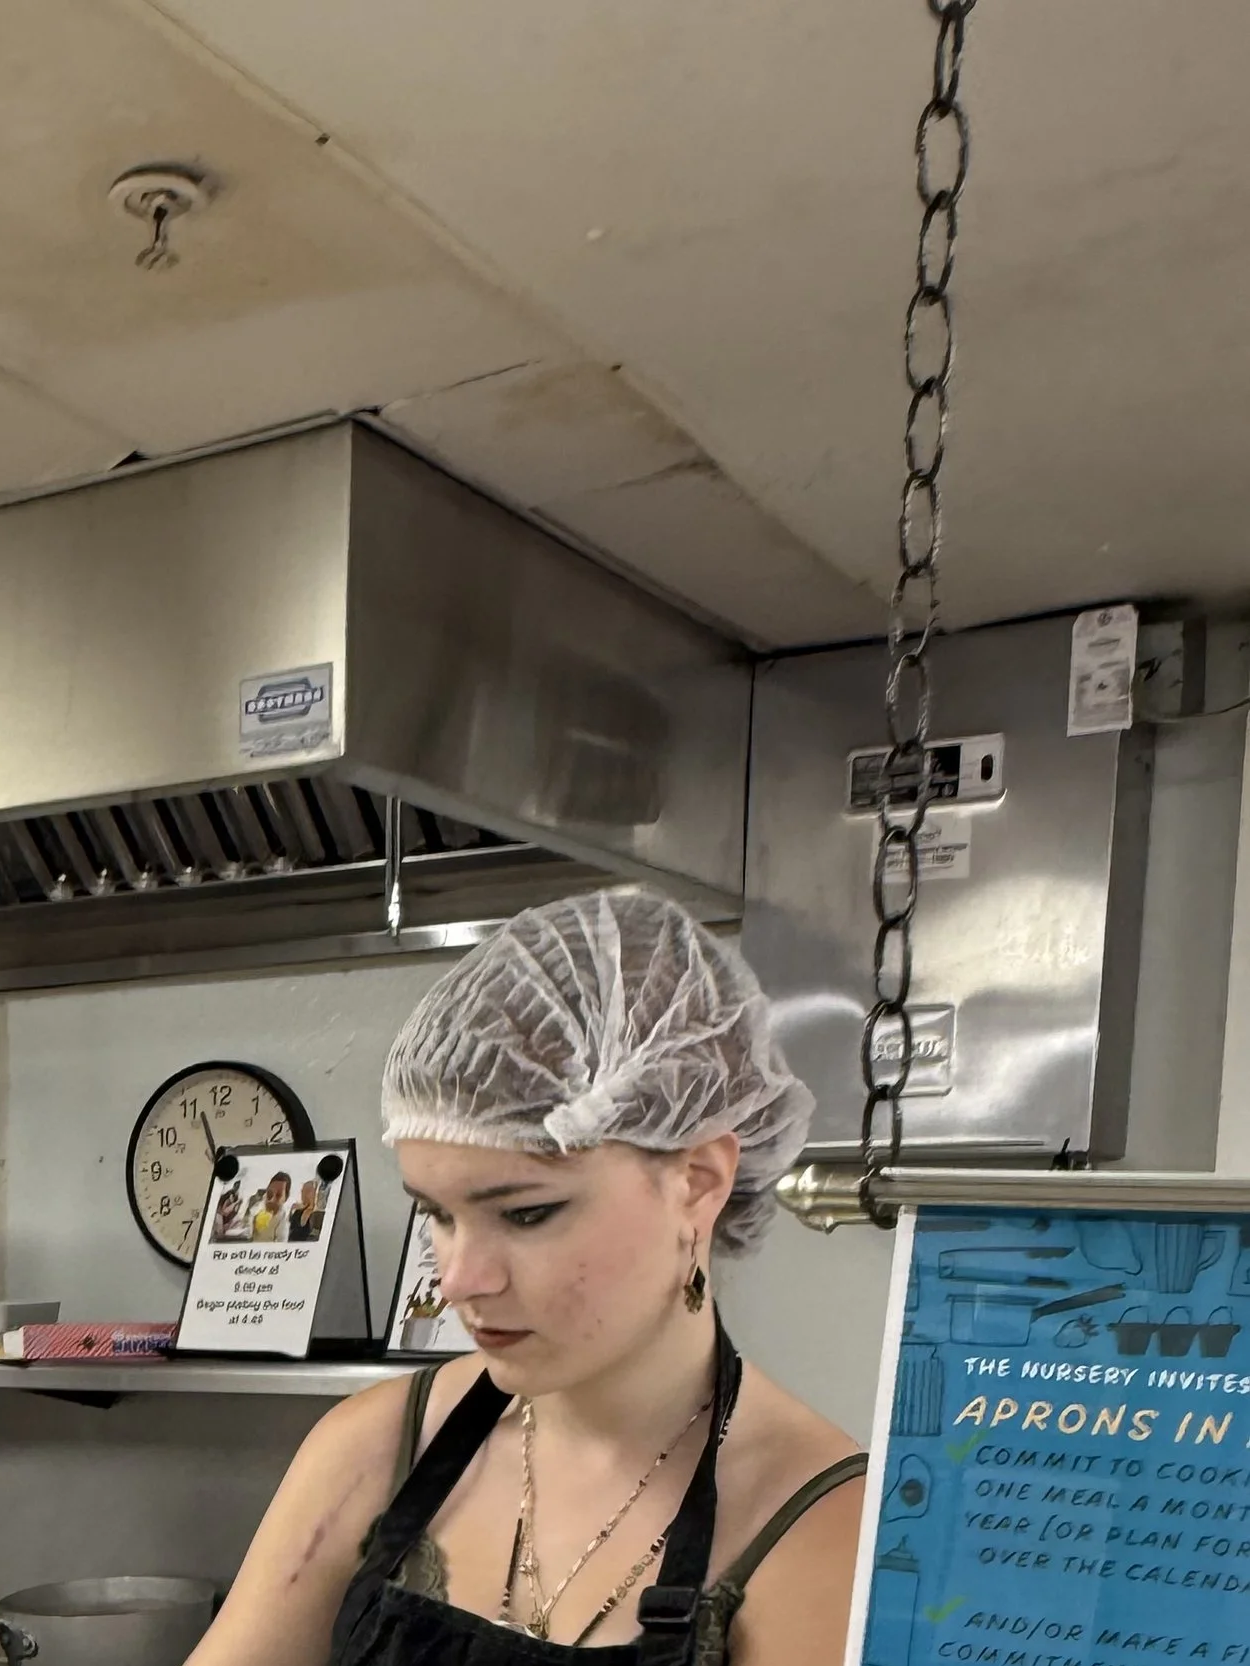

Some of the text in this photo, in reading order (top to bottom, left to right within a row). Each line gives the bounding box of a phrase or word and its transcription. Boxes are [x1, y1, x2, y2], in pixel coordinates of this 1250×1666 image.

[209, 1085, 232, 1106] 12
[251, 1095, 260, 1116] 1
[179, 1098, 198, 1119] 11
[157, 1127, 178, 1148] 10
[270, 1121, 285, 1144] 2
[150, 1161, 162, 1181] 9
[159, 1195, 171, 1217] 8
[182, 1220, 195, 1241] 7
[964, 1357, 1250, 1394] THE NURSERY INVITES
[953, 1395, 1234, 1445] APRONS IN
[976, 1445, 1102, 1472] COMMIT
[1110, 1457, 1142, 1477] TO
[976, 1480, 1032, 1500] ONE
[1041, 1486, 1120, 1509] MEAL
[1128, 1495, 1149, 1511] A
[965, 1511, 1250, 1557] YEAR (OR PLAN FOR
[979, 1547, 1050, 1568] OVER
[1064, 1556, 1117, 1578] THE
[964, 1611, 1249, 1663] AND/OR MAKE A FI
